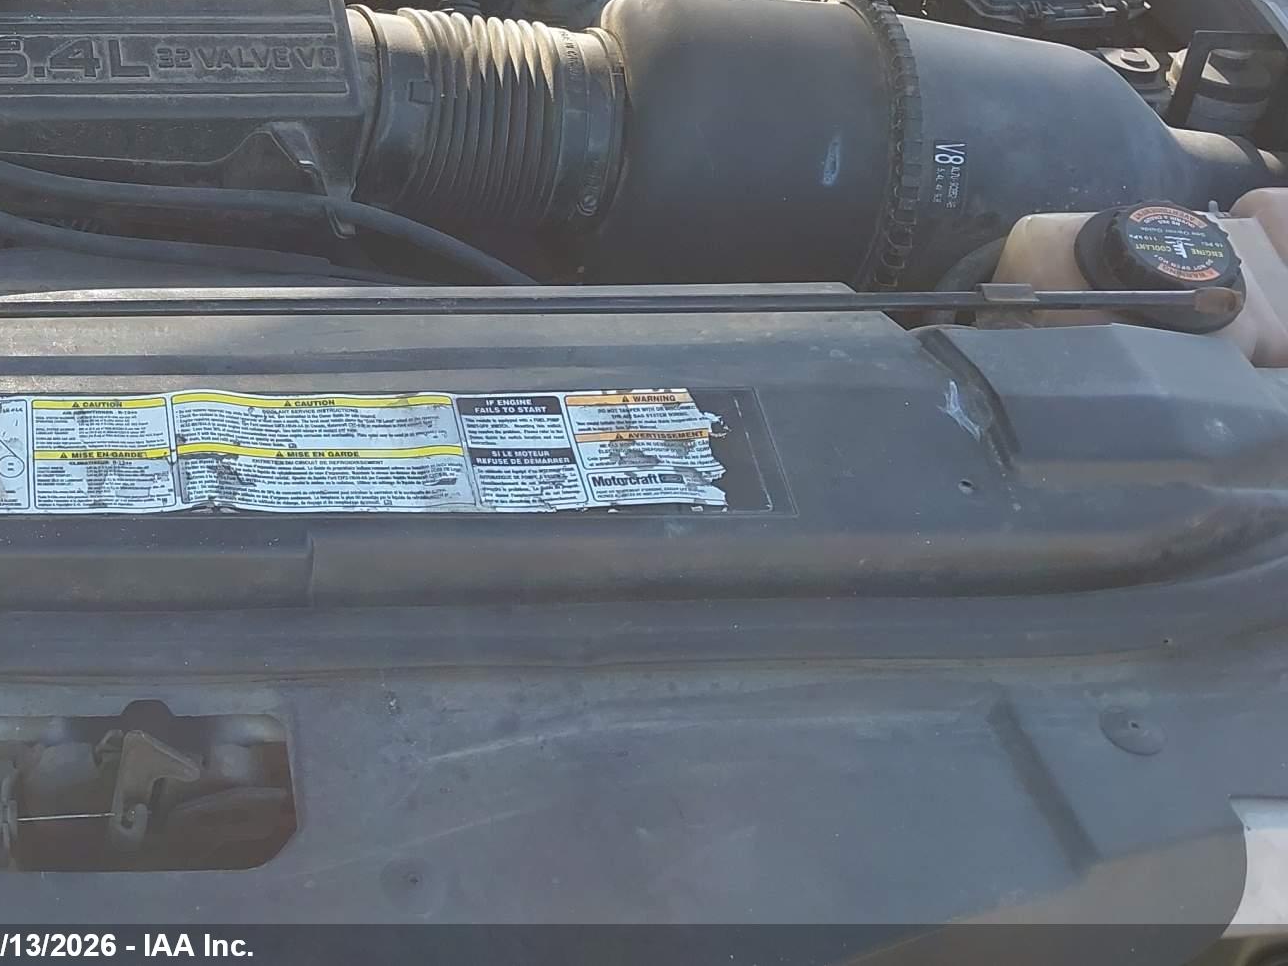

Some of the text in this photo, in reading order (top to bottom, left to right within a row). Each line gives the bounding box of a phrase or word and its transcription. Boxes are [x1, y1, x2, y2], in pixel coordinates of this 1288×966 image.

[935, 143, 966, 165] V8
[1135, 243, 1224, 258] ENGINE COOLANT
[592, 474, 658, 487] Motorcraft
